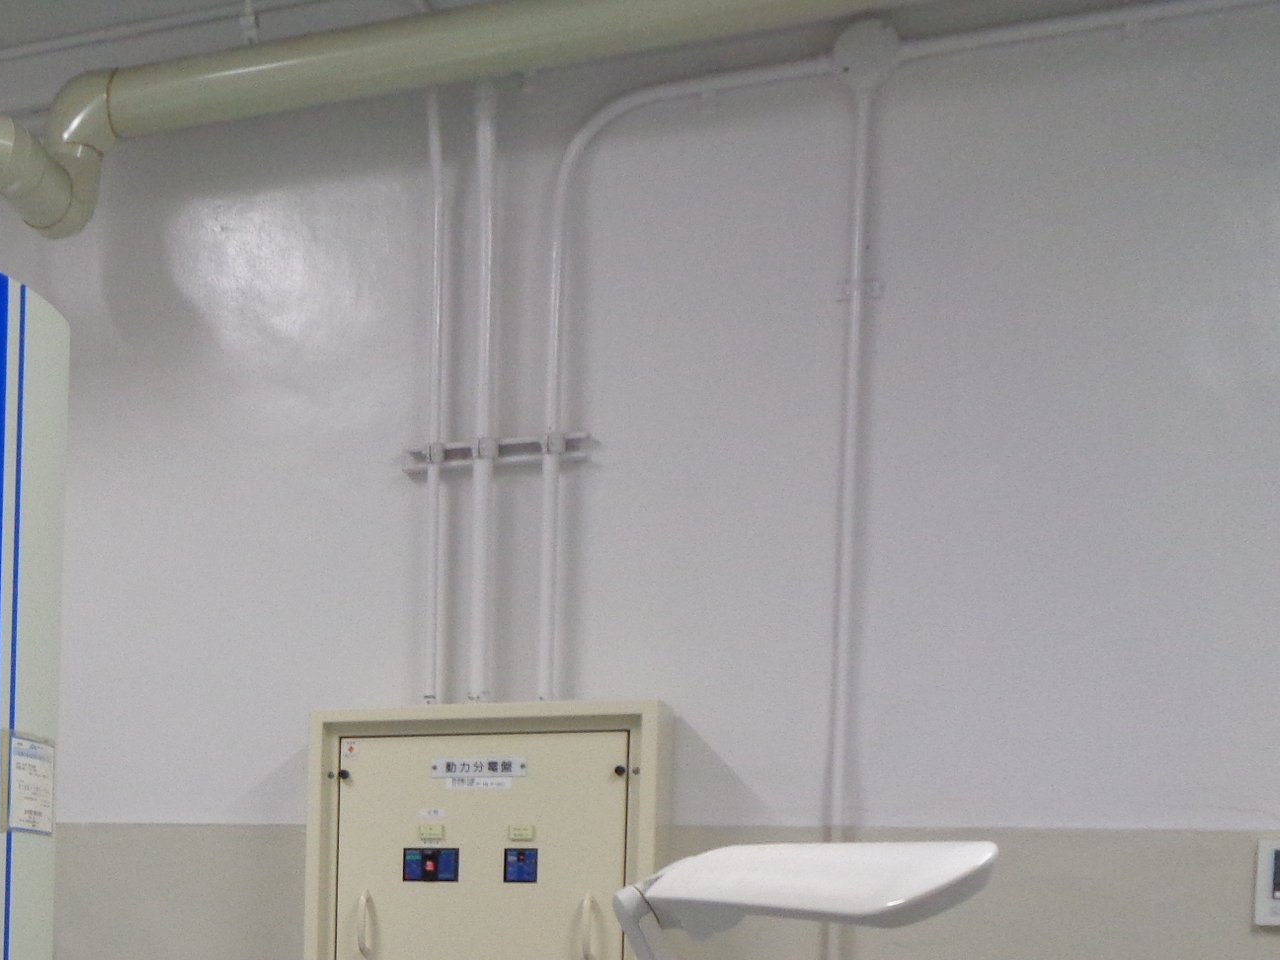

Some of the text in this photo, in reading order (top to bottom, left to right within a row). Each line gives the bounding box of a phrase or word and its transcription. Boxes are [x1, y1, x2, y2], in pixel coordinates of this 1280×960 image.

[445, 761, 512, 774] 動力分電盤
